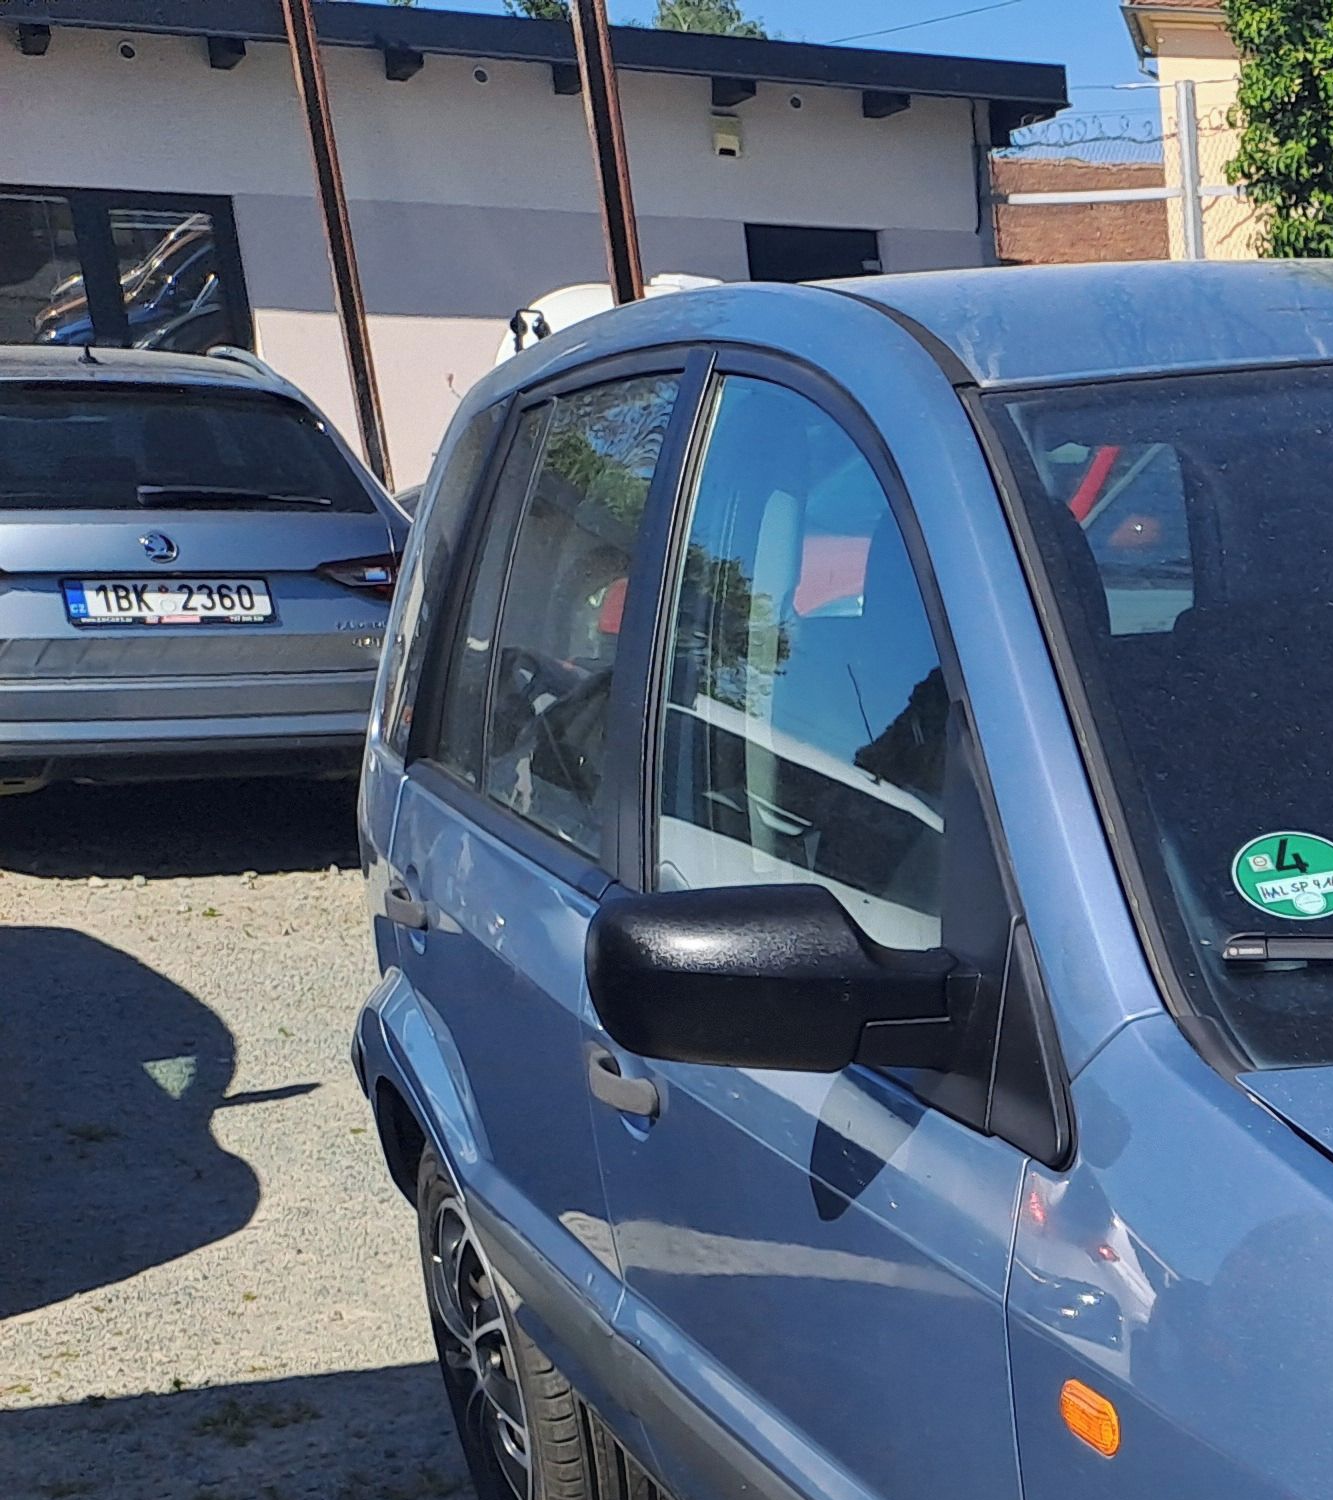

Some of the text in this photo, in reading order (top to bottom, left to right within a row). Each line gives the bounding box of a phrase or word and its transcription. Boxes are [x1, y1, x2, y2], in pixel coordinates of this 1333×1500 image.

[71, 604, 86, 614] CZ
[96, 584, 255, 612] 1BK 2360
[1276, 838, 1309, 873] 4
[1260, 885, 1289, 900] HAL
[1291, 880, 1308, 893] SP
